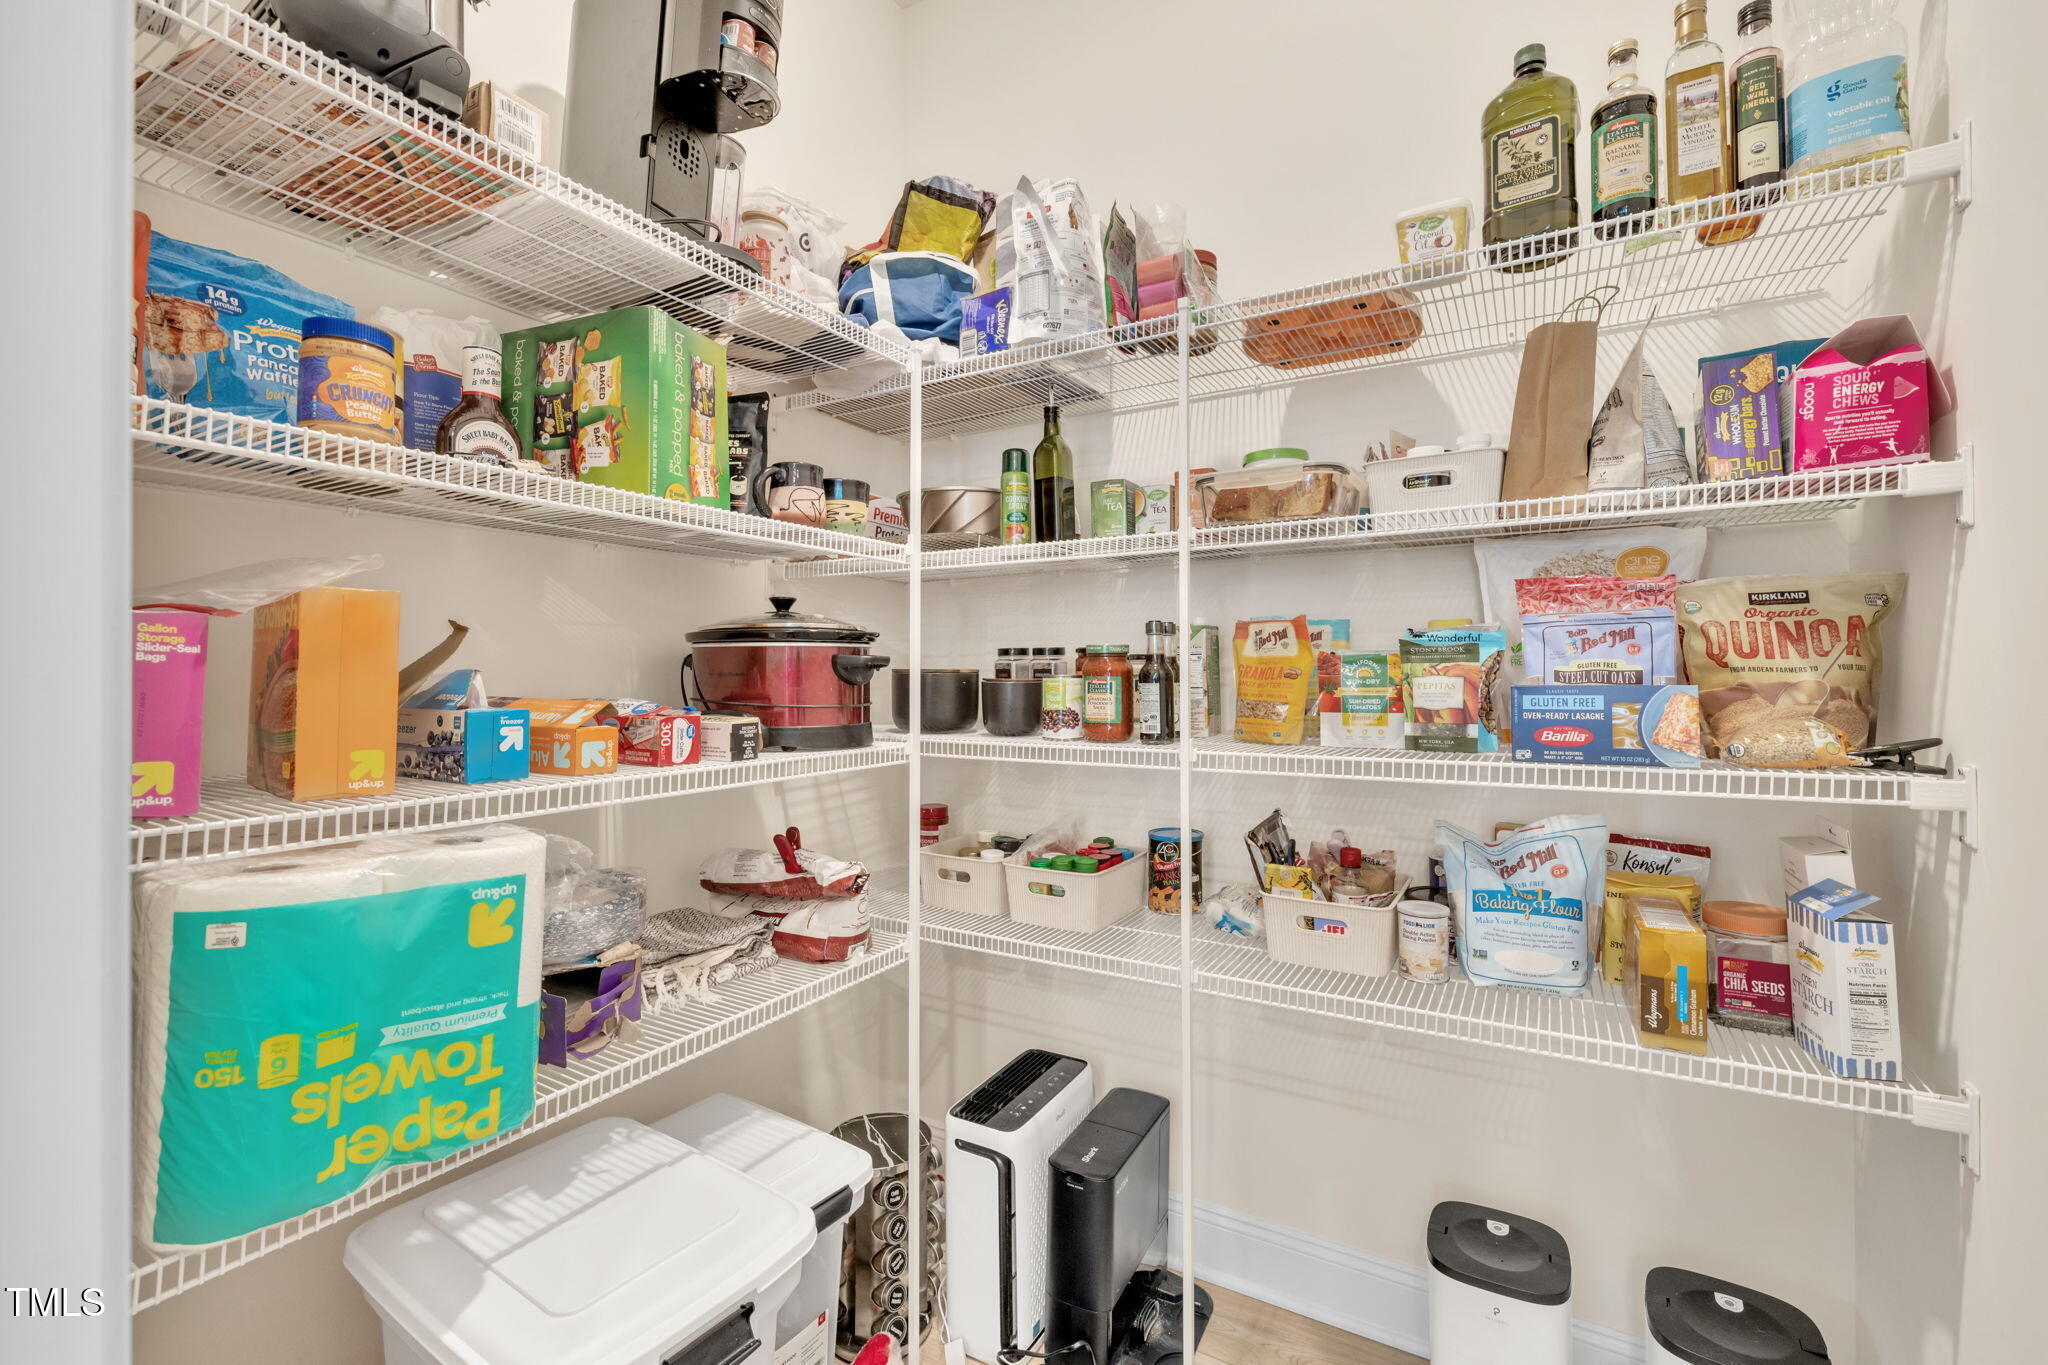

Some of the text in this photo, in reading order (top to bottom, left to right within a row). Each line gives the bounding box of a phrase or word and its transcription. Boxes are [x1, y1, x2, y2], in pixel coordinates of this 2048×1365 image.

[1749, 82, 1765, 91] RED
[1842, 84, 1868, 95] Gather
[1747, 89, 1768, 101] WINE
[1741, 96, 1775, 112] VINEGAR
[1827, 95, 1890, 118] Vegetable Oil
[1509, 121, 1541, 136] KIRKLAND
[1606, 125, 1639, 138] ITALIAN
[1681, 127, 1717, 140] MODENA
[1684, 123, 1710, 134] WHITE
[1682, 134, 1717, 146] VINEGAR
[1605, 141, 1642, 157] BALSAMIC
[1606, 149, 1641, 163] VINEGAR
[1497, 164, 1554, 186] EXTRA VIRGIN
[1413, 226, 1445, 242] Coconut
[1414, 239, 1429, 252] Oil
[213, 301, 242, 314] protein
[994, 298, 1006, 344] Kleenex
[233, 330, 299, 364] Prot
[558, 344, 566, 377] BAKED
[473, 368, 485, 376] The
[512, 339, 527, 402] baked &
[1833, 371, 1871, 387] SOUR
[1833, 381, 1884, 398] ENERGY
[327, 382, 394, 414] CRUNCHY
[671, 331, 685, 477] baked & popped
[1799, 382, 1815, 420] noogs
[1832, 395, 1879, 409] CHEWS
[344, 400, 384, 416] Peanut
[1842, 412, 1860, 420] nutrition
[1874, 408, 1895, 416] actually
[346, 409, 383, 423] Butter
[1743, 419, 1759, 448] energy
[462, 429, 513, 453] SWEET BABY RAY'S
[1106, 502, 1123, 511] TEA
[1152, 505, 1167, 514] TEA
[1751, 592, 1807, 601] KIRKLAND
[1744, 607, 1821, 621] Organic
[137, 622, 177, 635] Gallon
[137, 632, 185, 645] Storage
[1259, 629, 1288, 649] Red Mill
[1427, 634, 1480, 643] Wonderful
[1580, 626, 1636, 655] Red Mill
[1700, 615, 1866, 668] QUINOA
[135, 642, 201, 655] Slider-Seal
[135, 651, 166, 663] Bags
[1239, 666, 1284, 680] GRANOLA
[1577, 662, 1601, 670] GLUTEN
[1730, 666, 1746, 674] FROM
[1776, 666, 1808, 674] FARMERS
[1837, 663, 1854, 672] YOUR
[1559, 671, 1636, 683] STEEL CUT OATS
[1417, 682, 1456, 690] PEPITAS
[1530, 697, 1596, 708] GLUTEN FREE
[500, 717, 524, 725] freezer
[1523, 712, 1605, 721] OVEN-READY LASAGNE
[554, 733, 572, 741] up&up
[660, 722, 671, 747] 300
[1541, 731, 1586, 742] Barilla
[348, 778, 384, 789] up&up
[1157, 862, 1175, 870] Gluten
[1499, 844, 1558, 879] Red Mill
[1623, 850, 1674, 876] Konsyl
[471, 883, 517, 901] up&up
[1475, 893, 1583, 920] Baking Flour
[1513, 919, 1540, 927] Recipes
[1543, 922, 1566, 931] Gluten
[1568, 925, 1580, 934] Free
[1402, 933, 1416, 941] Baking
[1723, 971, 1746, 979] ORGANIC
[1846, 967, 1887, 975] STARCH
[1723, 977, 1785, 996] CHIA SEEDS
[1801, 973, 1817, 989] CORN
[1792, 977, 1834, 1016] STARCH
[401, 995, 488, 1017] strong and absorbent
[1645, 988, 1664, 1029] Wegmans
[392, 1007, 498, 1038] Premium Quality
[270, 1057, 287, 1075] 6
[193, 1065, 246, 1089] 150
[291, 1033, 504, 1129] Towels
[316, 1087, 501, 1183] Paper
[1082, 1146, 1099, 1163] Shark
